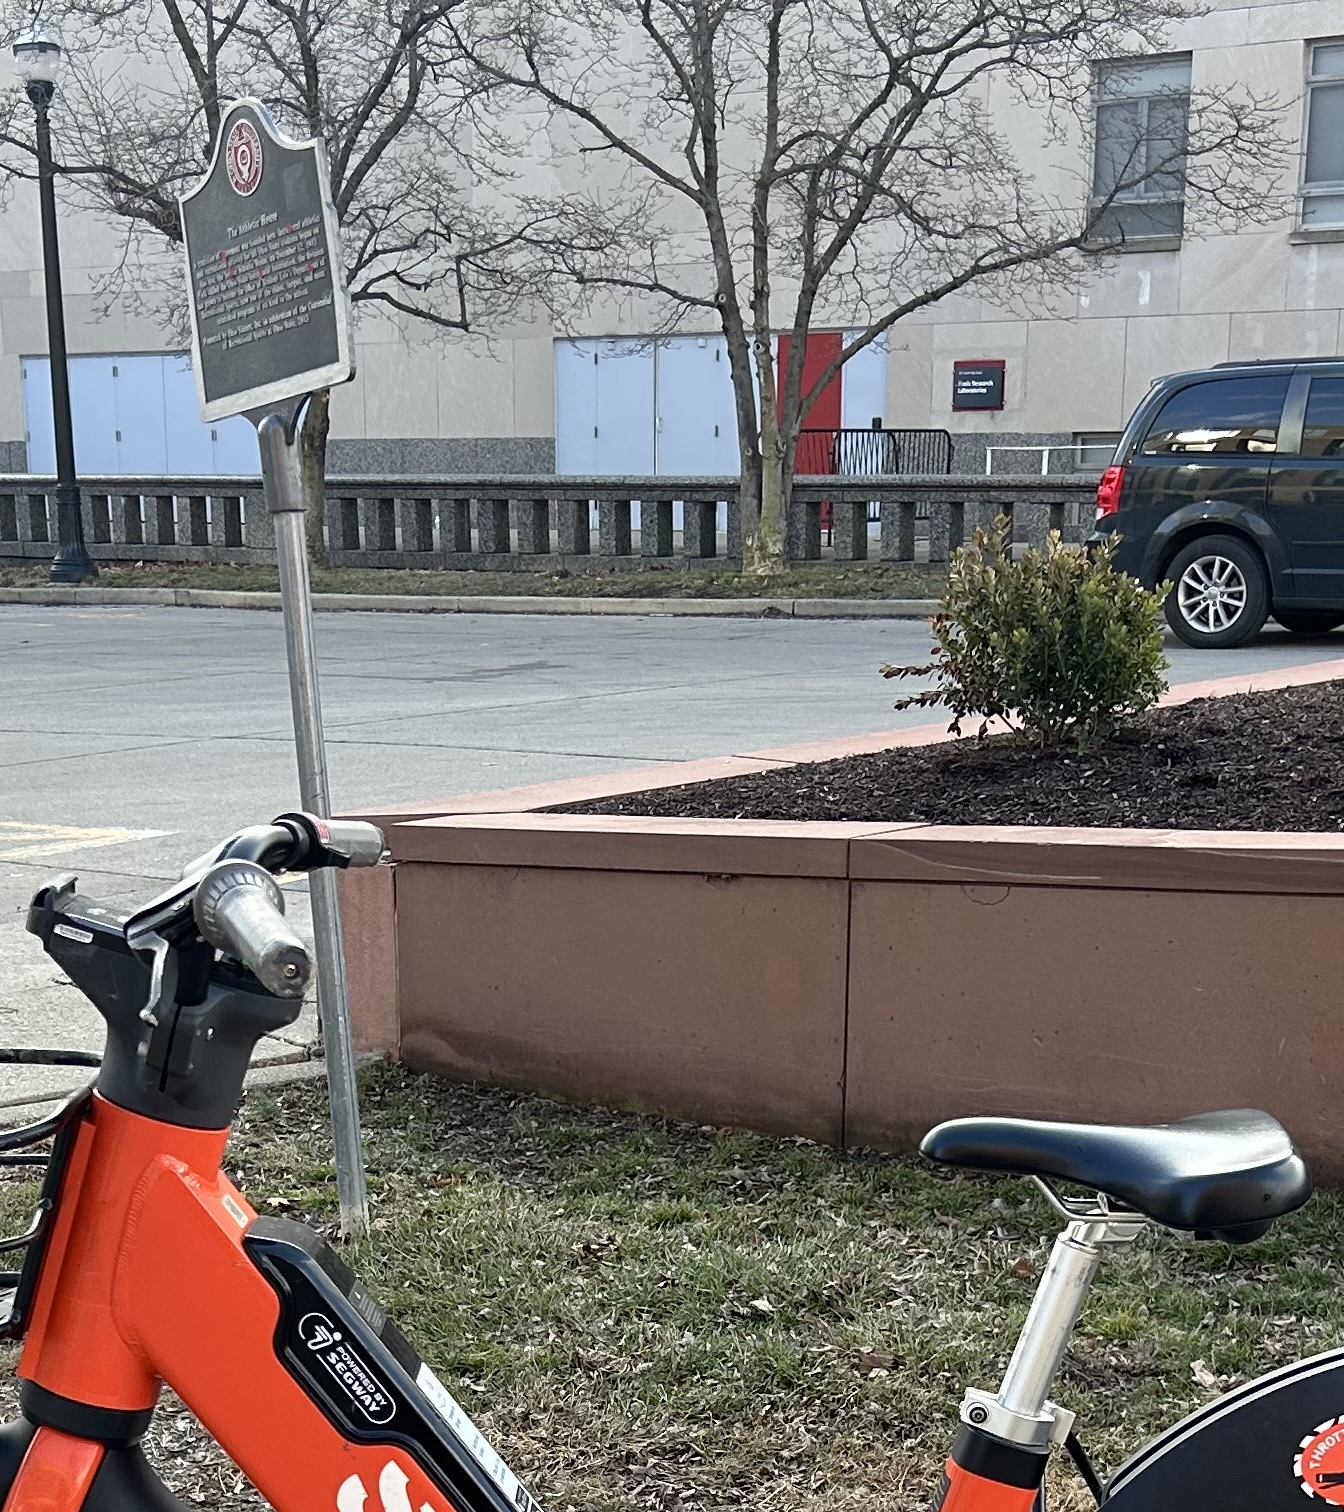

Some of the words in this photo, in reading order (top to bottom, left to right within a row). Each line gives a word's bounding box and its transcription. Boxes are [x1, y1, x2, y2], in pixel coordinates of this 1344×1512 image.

[326, 1351, 381, 1412] SEGWAY
[336, 1346, 376, 1393] POWERED
[373, 1392, 388, 1405] BY
